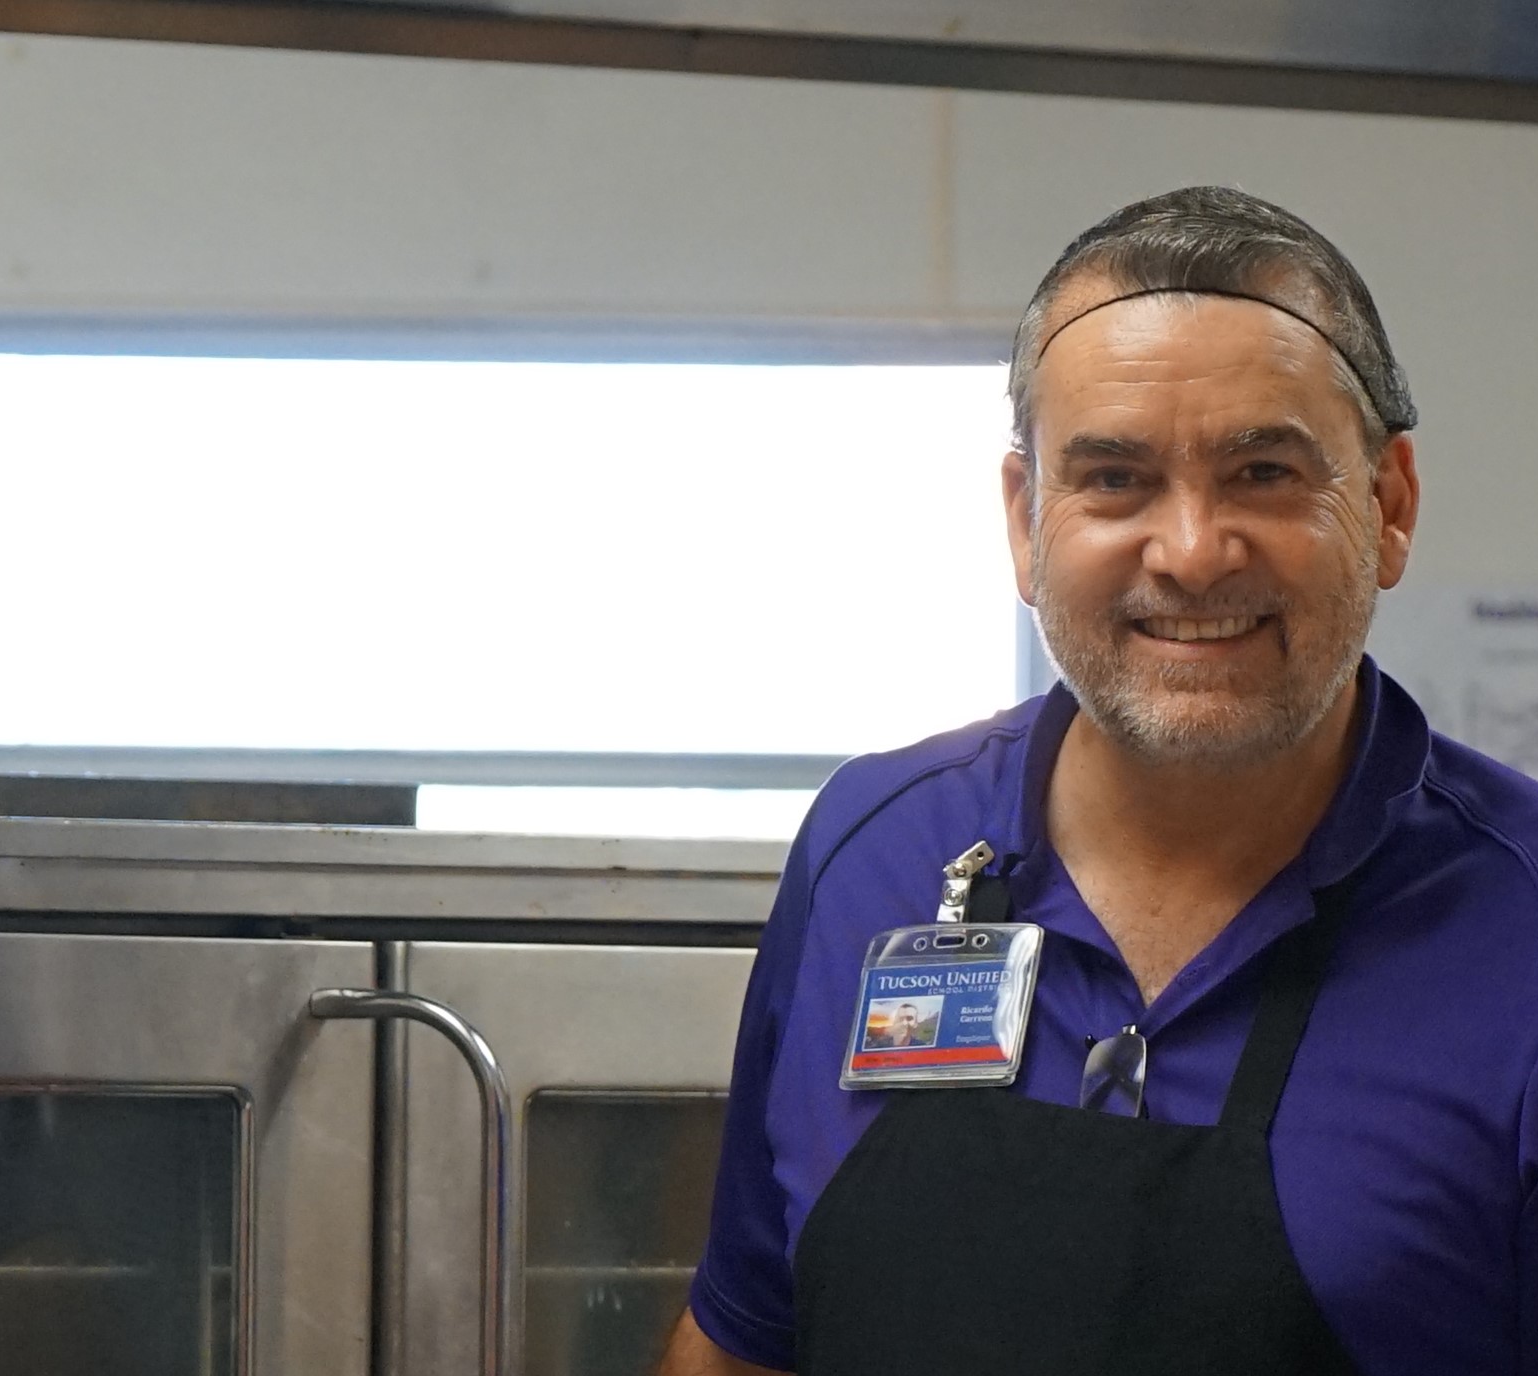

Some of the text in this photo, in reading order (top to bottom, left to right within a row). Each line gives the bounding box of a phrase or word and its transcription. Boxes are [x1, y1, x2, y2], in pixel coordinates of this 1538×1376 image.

[878, 970, 1012, 990] TUCSON UNIFIED
[927, 986, 964, 995] SCHOOL
